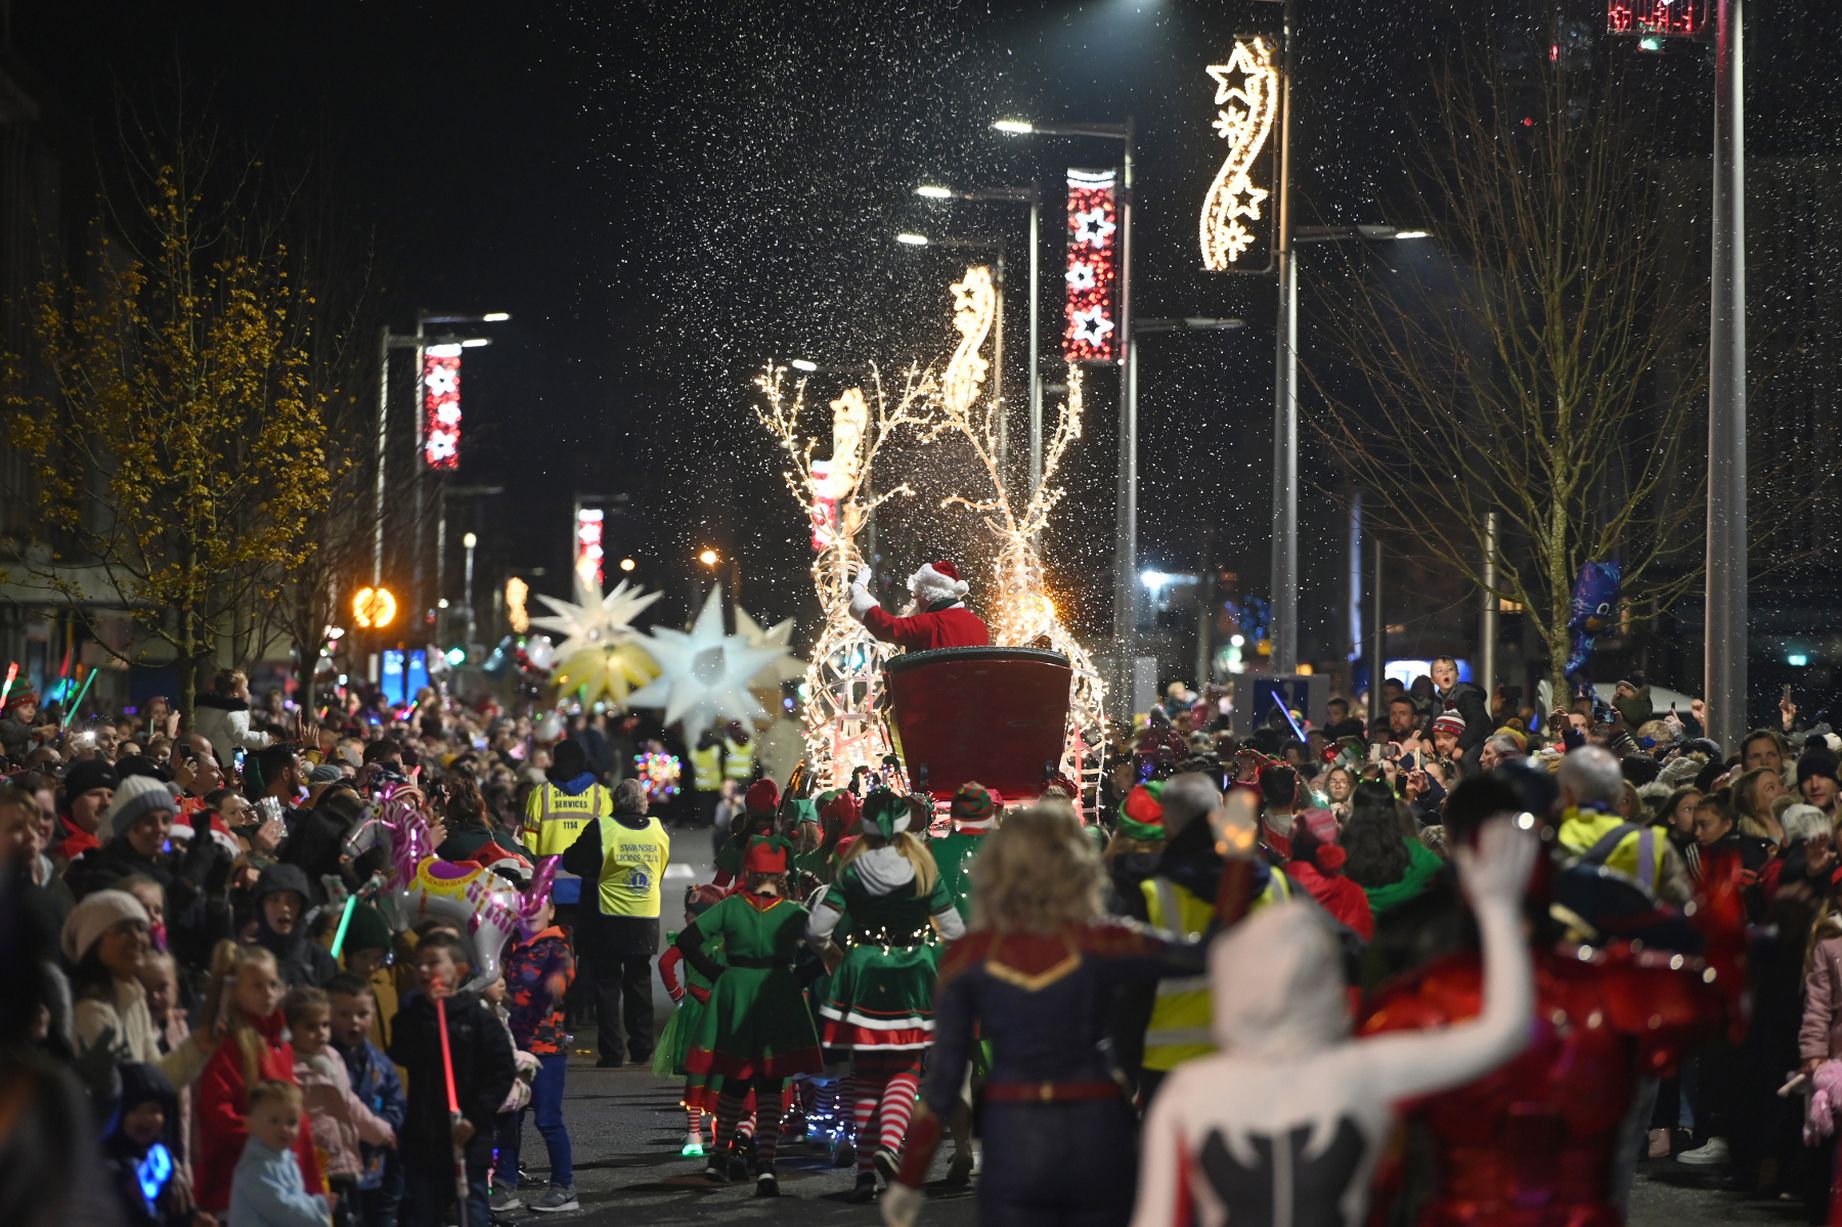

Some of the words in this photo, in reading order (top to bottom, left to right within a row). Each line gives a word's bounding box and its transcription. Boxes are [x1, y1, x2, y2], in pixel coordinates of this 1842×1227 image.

[554, 800, 588, 808] SERVICES
[563, 821, 578, 830] 1114
[620, 843, 658, 852] SWANSEA
[615, 854, 641, 862] LIONS
